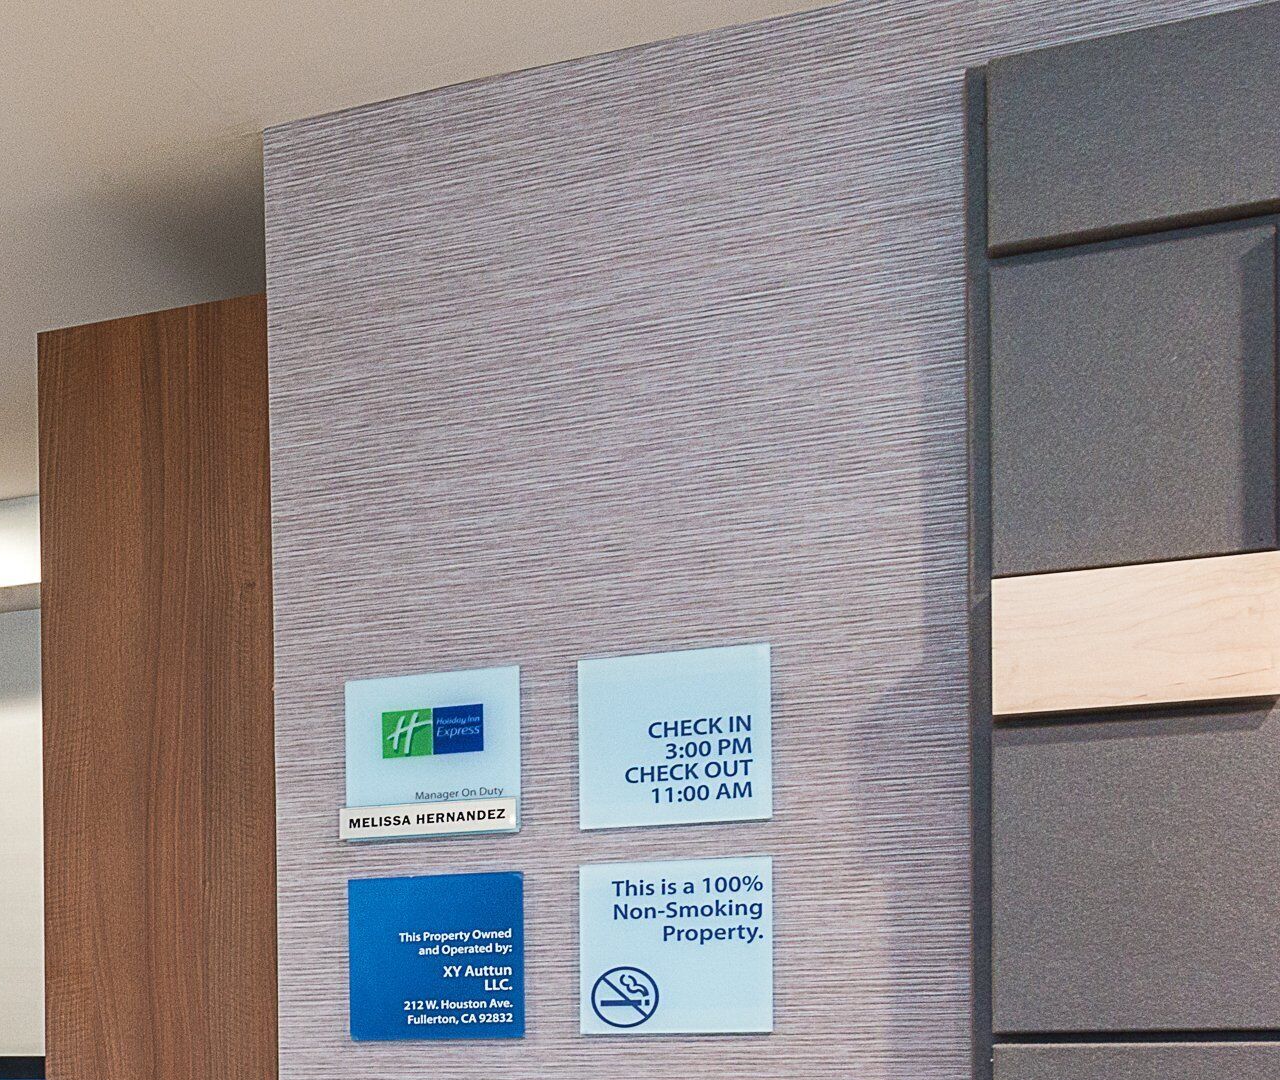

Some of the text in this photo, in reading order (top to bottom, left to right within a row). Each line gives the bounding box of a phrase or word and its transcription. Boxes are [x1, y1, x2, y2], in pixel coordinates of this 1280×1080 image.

[436, 725, 480, 739] Express
[648, 714, 752, 739] CHECK IN
[665, 737, 752, 760] 3:00 PM
[624, 759, 754, 784] CHECK OUT
[415, 787, 504, 801] Manager On Duty
[652, 781, 753, 804] 11:00 AM
[349, 808, 506, 829] MELISSA HERNANDEZ
[611, 875, 764, 897] This is a 100%
[613, 899, 764, 920] Non-Smoking
[399, 928, 512, 943] This Property Owned
[663, 925, 764, 945] Property.
[418, 943, 513, 956] and Operated by:
[443, 965, 512, 978] XY Auttun
[484, 979, 513, 991] LLC.
[403, 998, 513, 1010] 212 W. Houston Ave.
[407, 1012, 513, 1025] Fullerton, CA 92832
